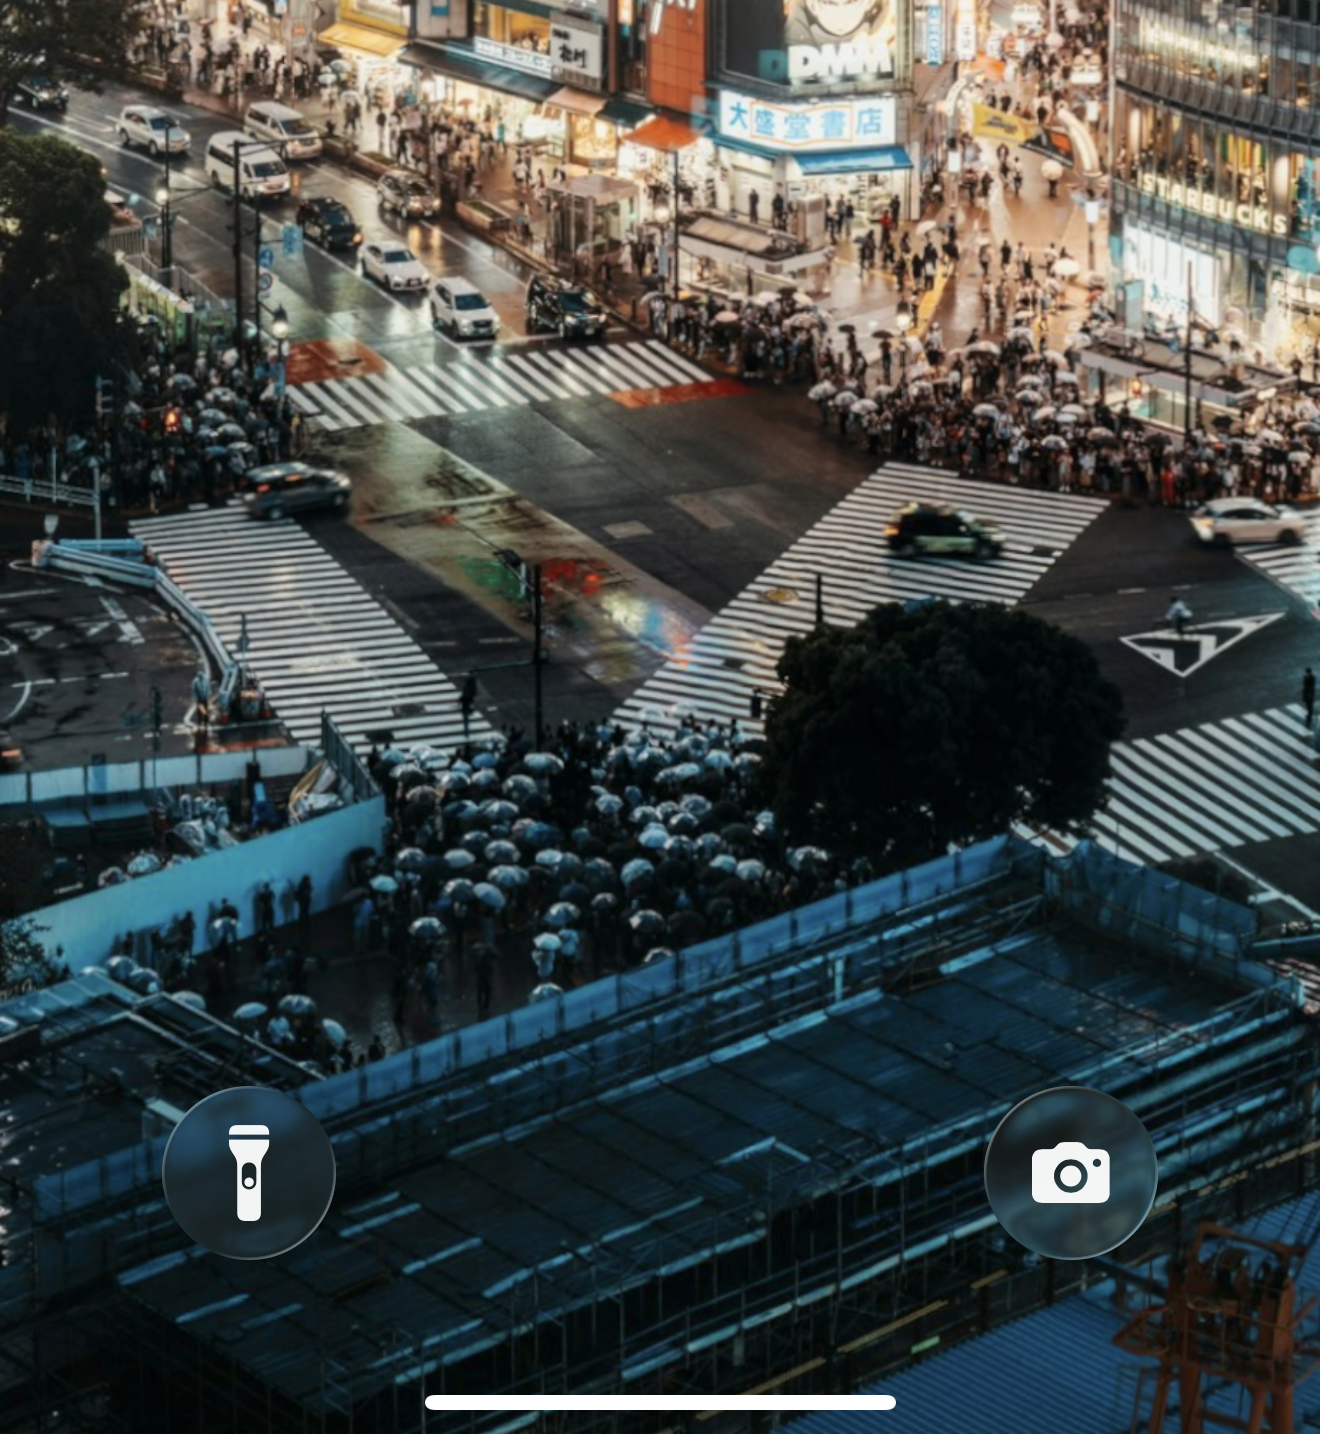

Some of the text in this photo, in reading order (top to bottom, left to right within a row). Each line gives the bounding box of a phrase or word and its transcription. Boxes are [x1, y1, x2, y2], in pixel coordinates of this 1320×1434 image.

[787, 42, 894, 80] DMM
[729, 100, 884, 140] 大盛堂書店
[1142, 172, 1288, 236] STARBUCKS
